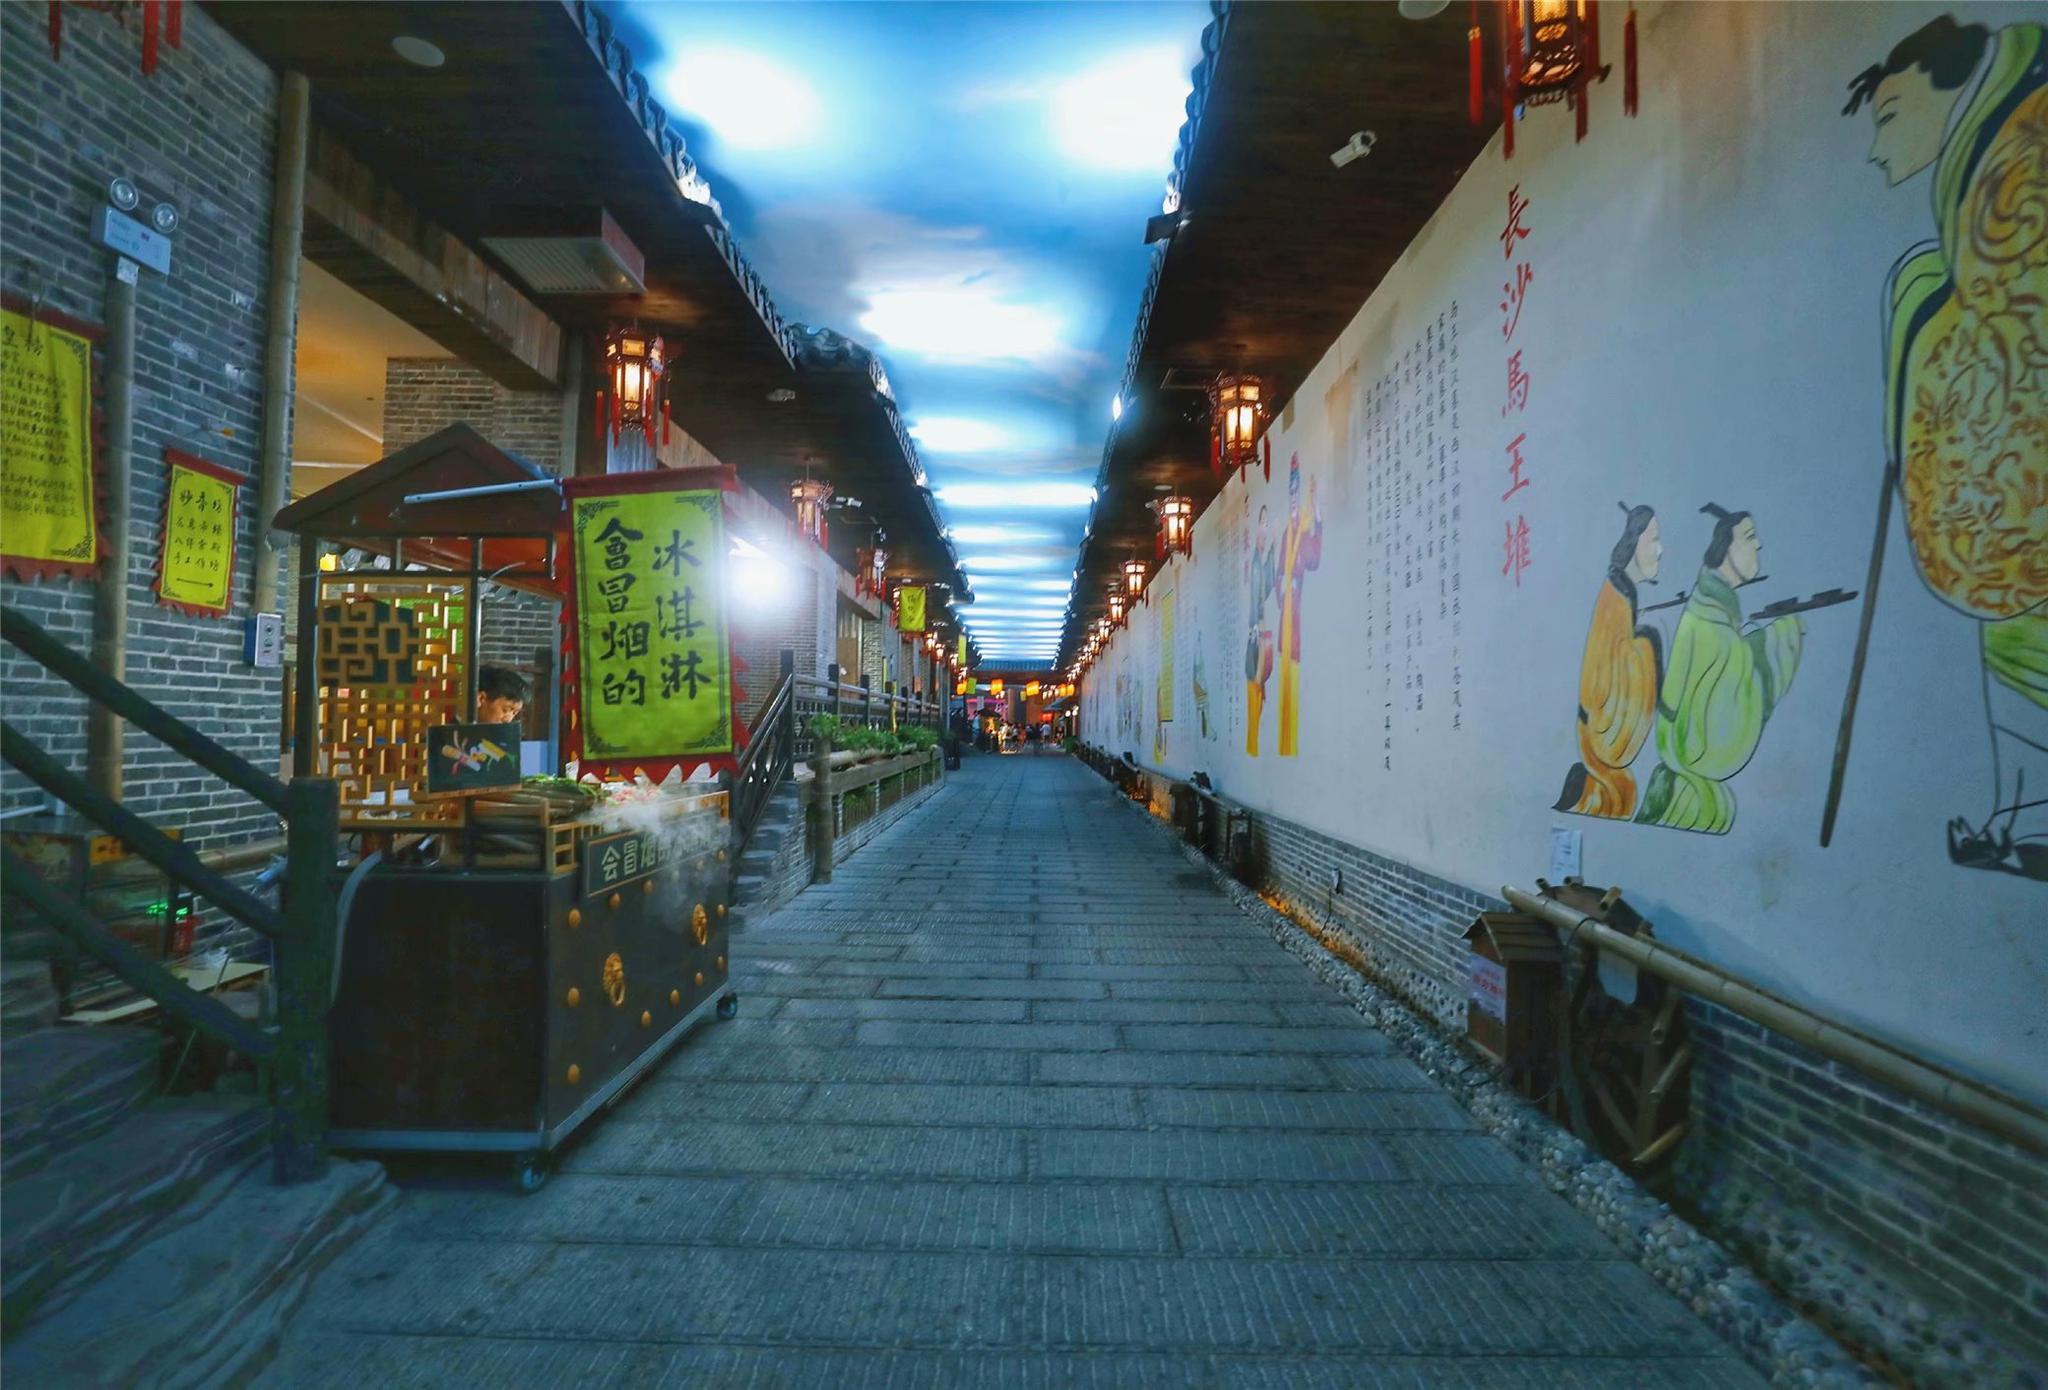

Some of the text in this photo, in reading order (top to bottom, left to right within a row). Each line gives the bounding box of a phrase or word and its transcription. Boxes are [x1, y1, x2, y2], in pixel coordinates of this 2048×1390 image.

[1499, 184, 1533, 588] 長沙馬王堆
[594, 517, 651, 707] 會冒烟的
[652, 529, 711, 702] 冰淇淋
